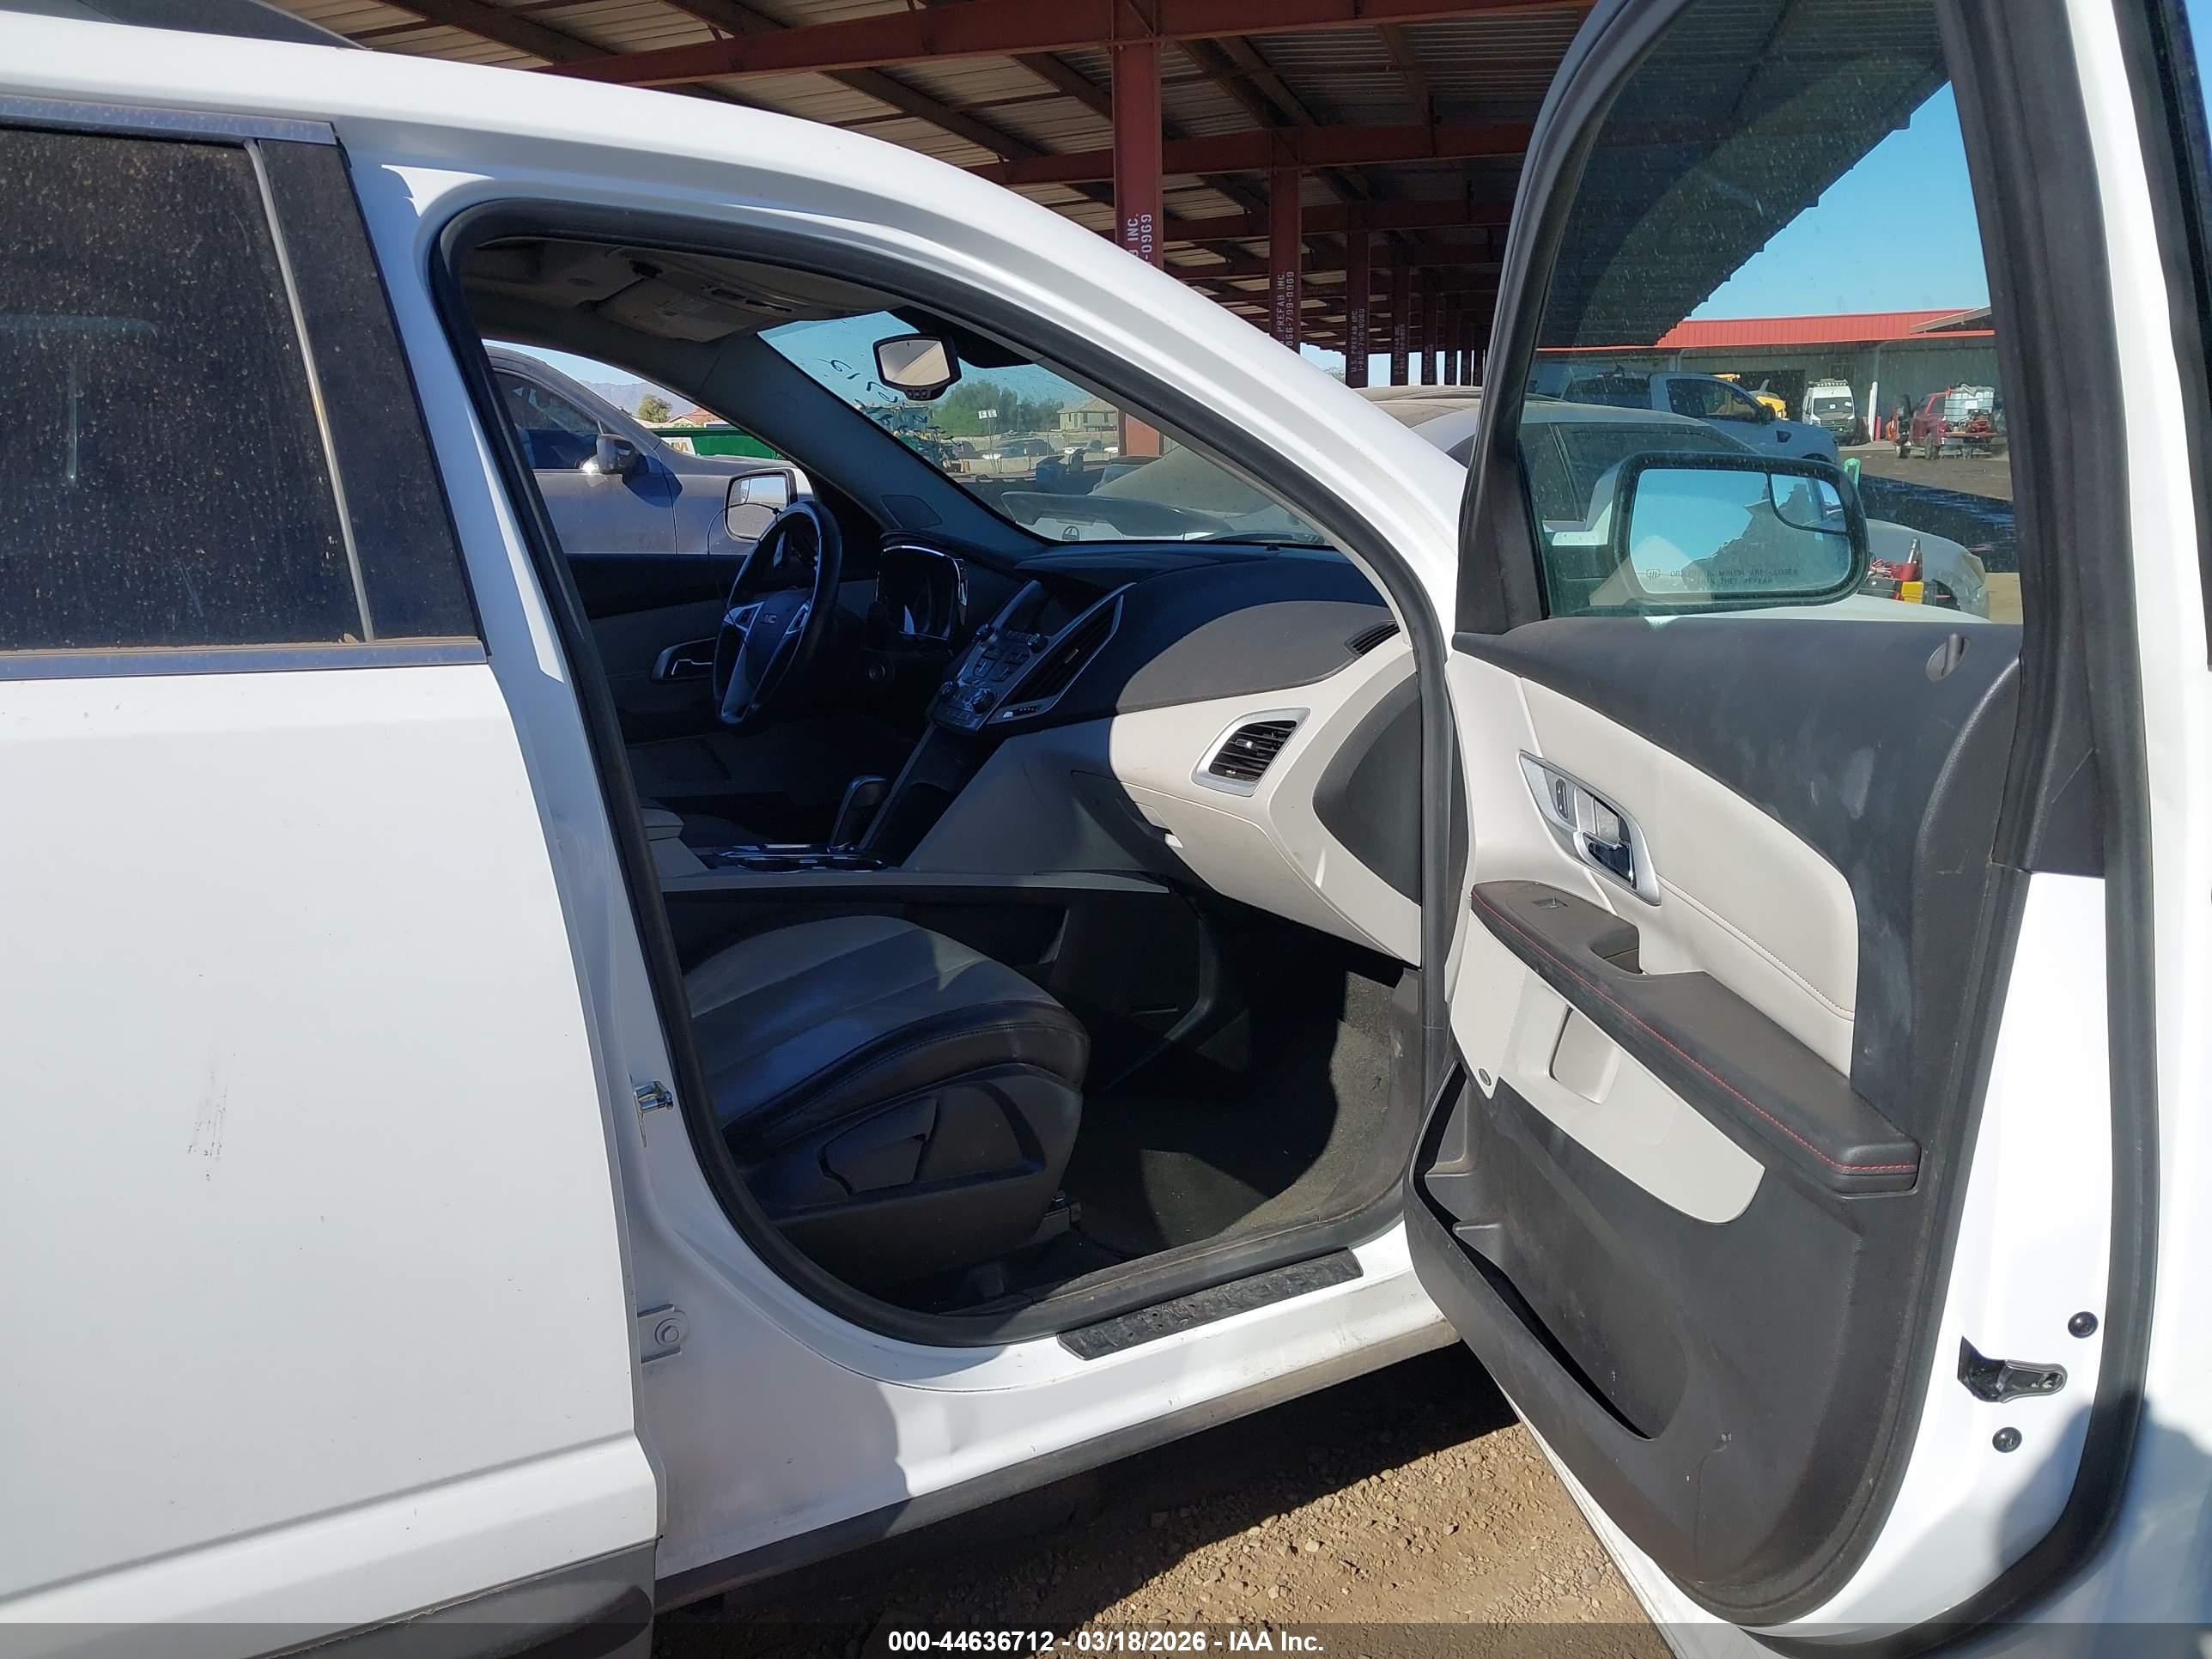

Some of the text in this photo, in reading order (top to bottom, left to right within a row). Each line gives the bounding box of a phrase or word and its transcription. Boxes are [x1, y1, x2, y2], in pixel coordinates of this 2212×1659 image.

[1127, 213, 1139, 241] INC.
[1277, 271, 1285, 289] INC.
[1276, 295, 1285, 332] PREFAB
